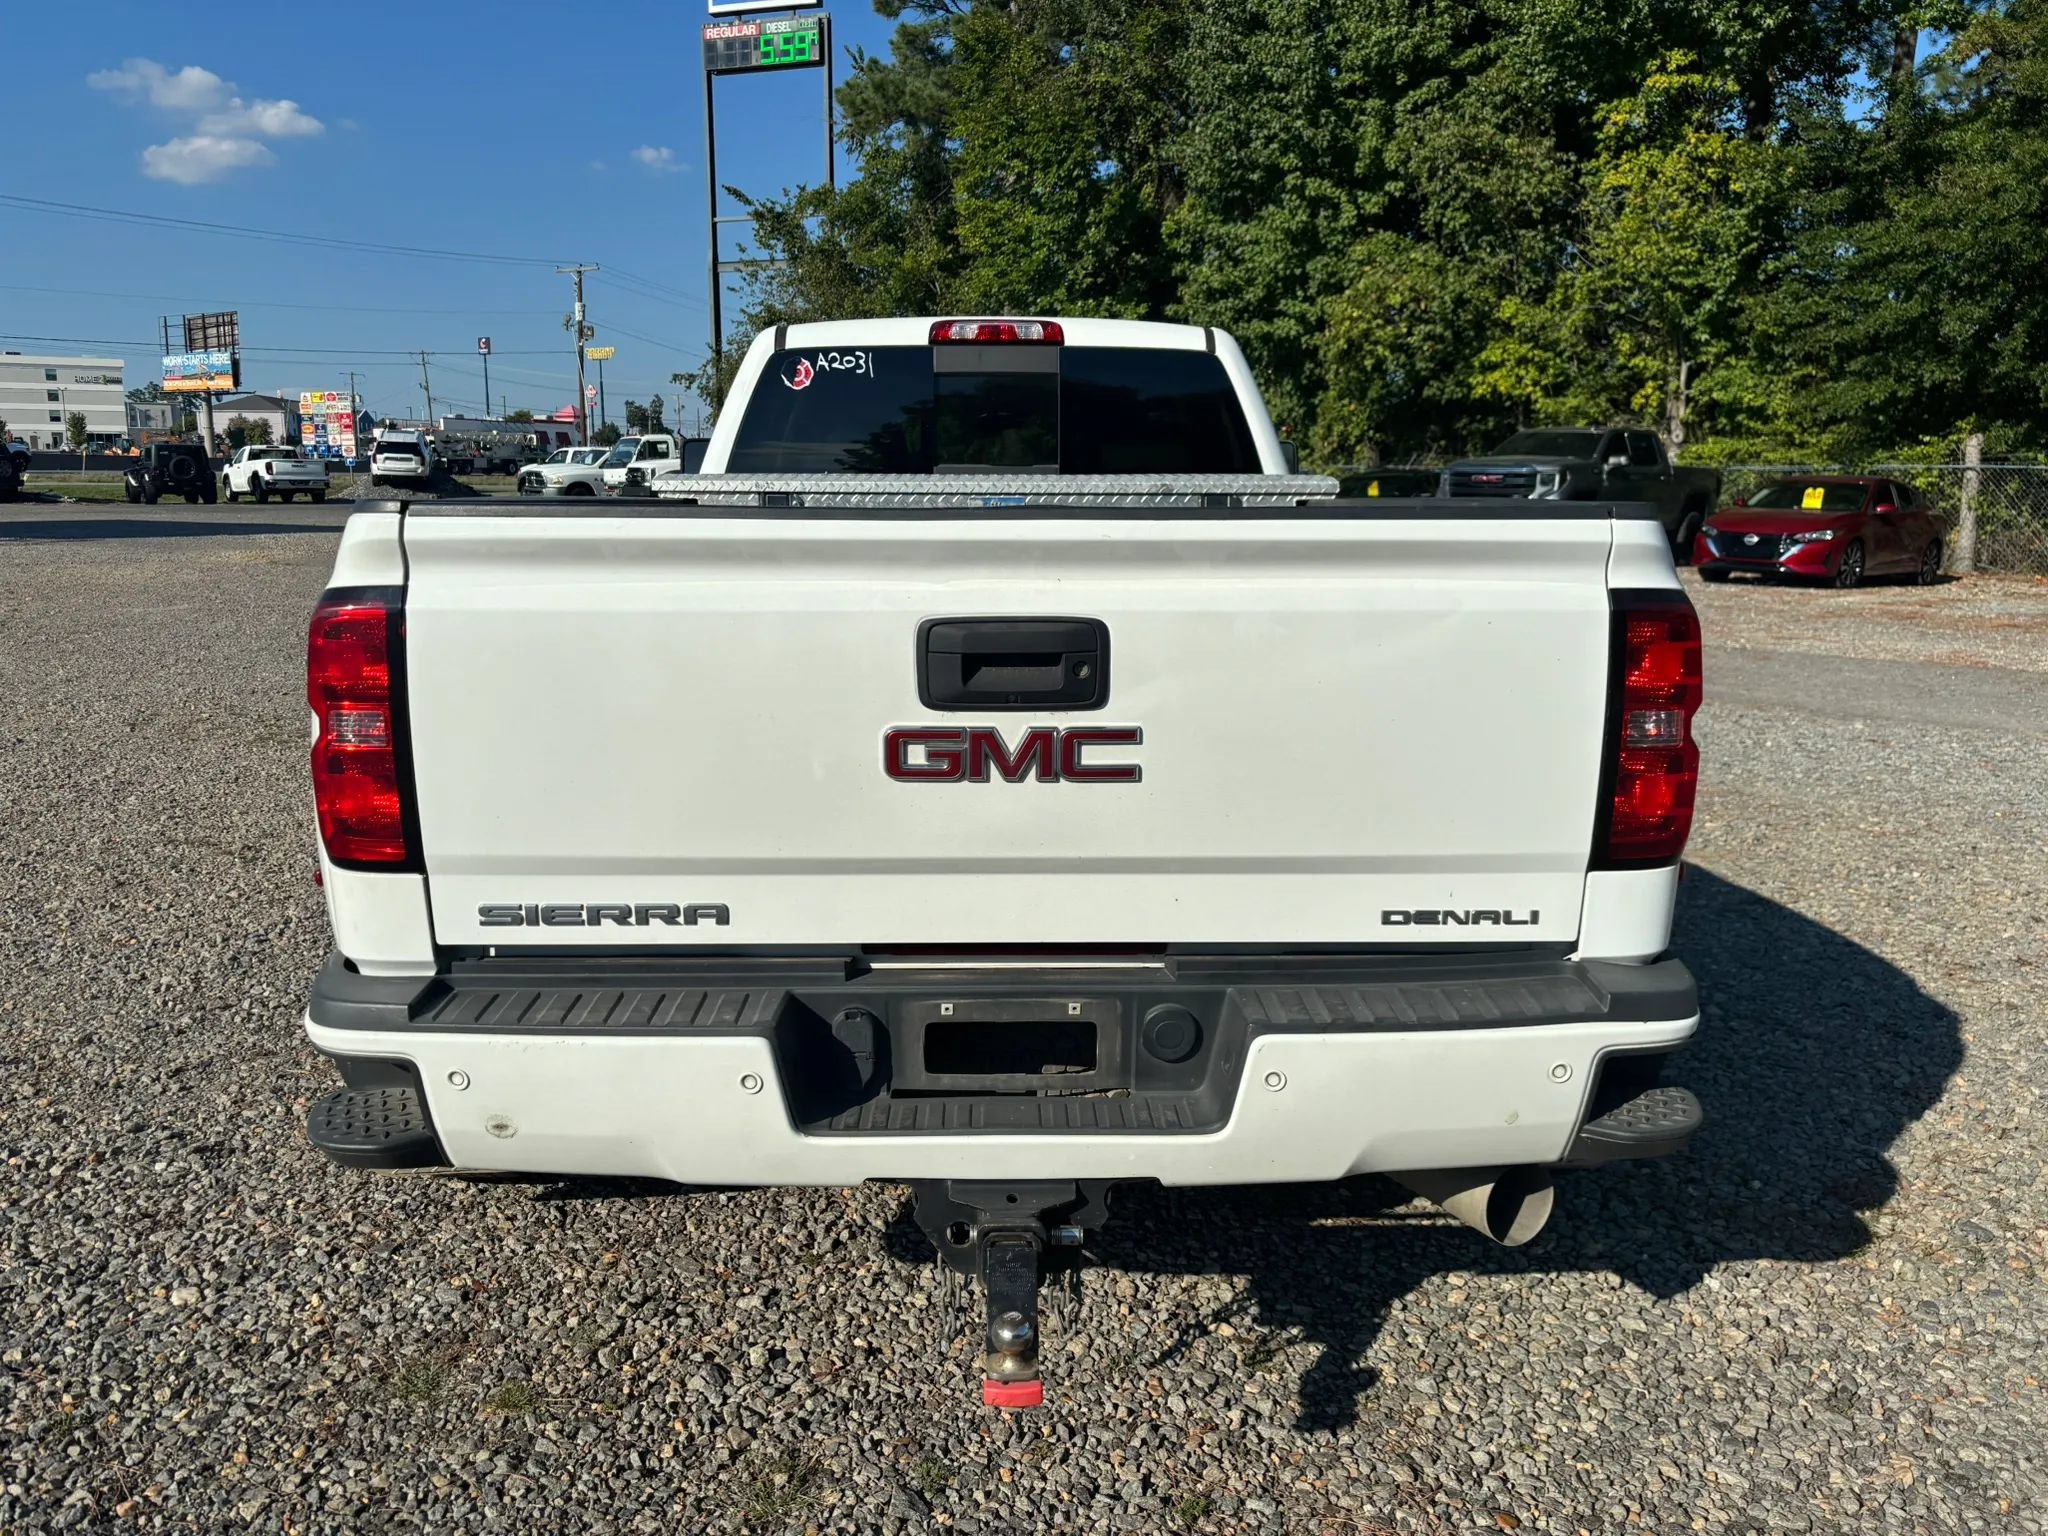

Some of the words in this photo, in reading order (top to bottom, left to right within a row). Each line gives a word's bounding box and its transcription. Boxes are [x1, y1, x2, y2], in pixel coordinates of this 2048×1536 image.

[706, 24, 756, 39] REGULAR
[766, 21, 792, 33] DIESEL
[183, 354, 209, 366] STARTS
[816, 351, 874, 378] A2031
[884, 725, 1143, 783] GMC
[478, 903, 730, 926] SIERRA
[1381, 910, 1540, 925] DENALI
